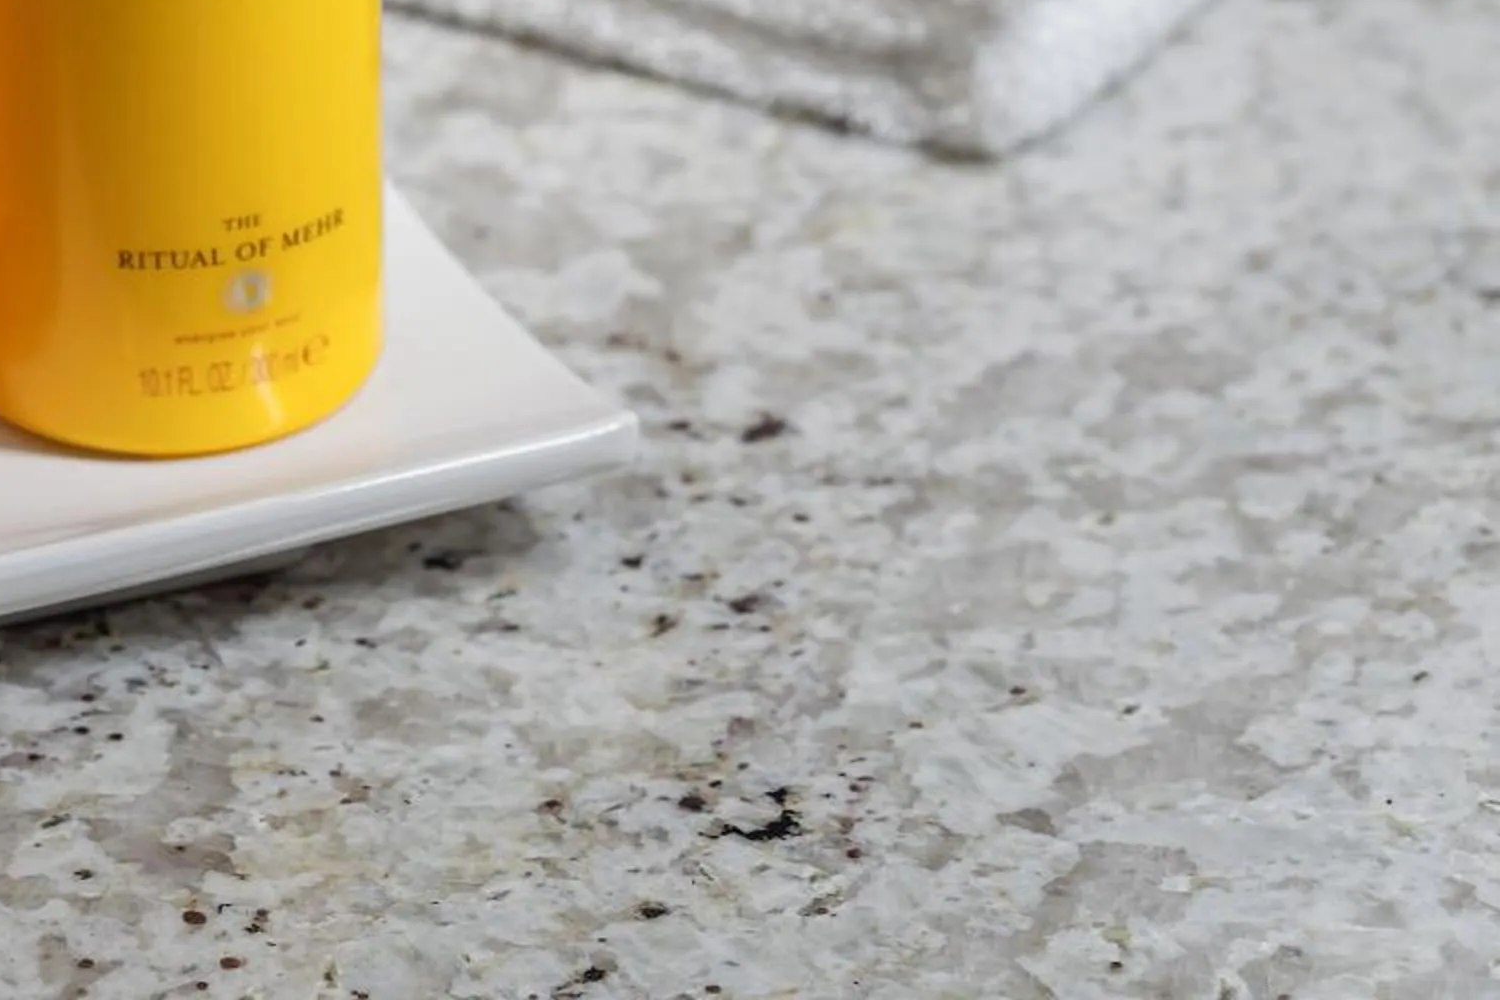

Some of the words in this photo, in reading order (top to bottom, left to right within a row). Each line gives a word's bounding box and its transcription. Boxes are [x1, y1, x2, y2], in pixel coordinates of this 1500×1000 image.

[117, 247, 226, 271] RITUAL
[234, 236, 272, 262] OF
[280, 207, 345, 252] MEHR
[222, 213, 262, 232] THE
